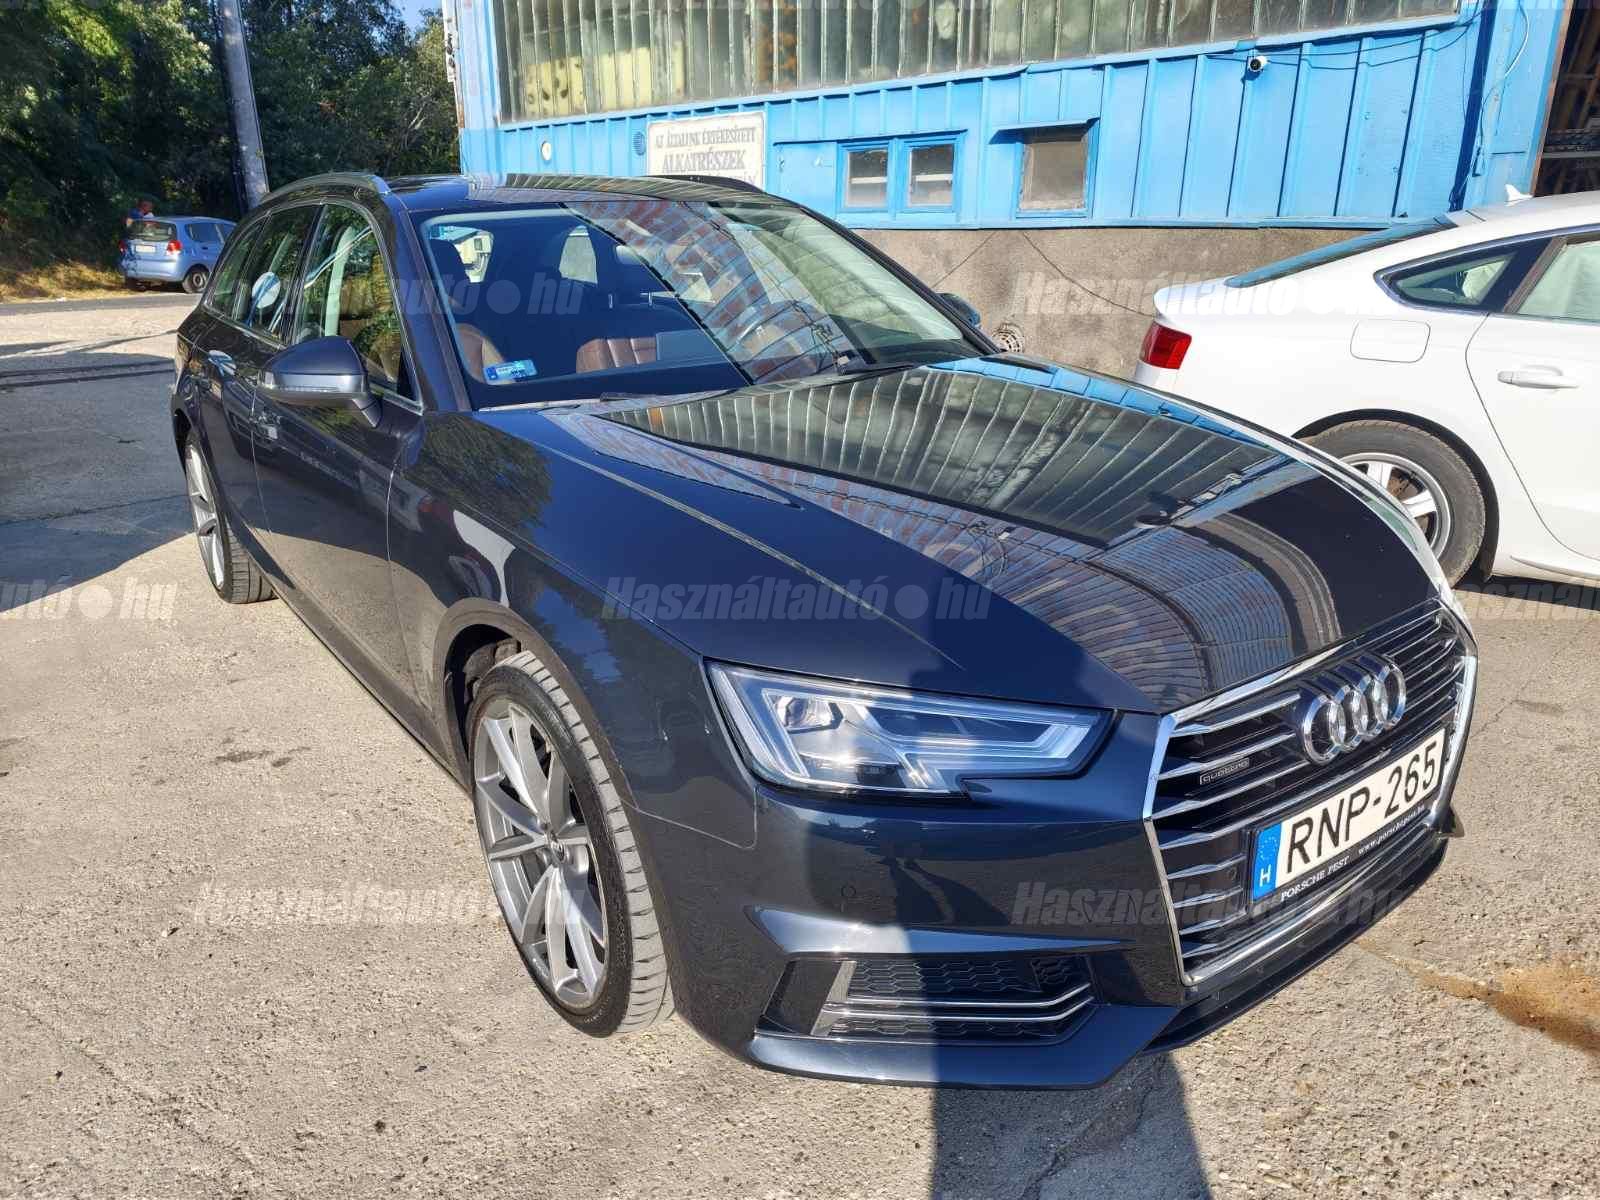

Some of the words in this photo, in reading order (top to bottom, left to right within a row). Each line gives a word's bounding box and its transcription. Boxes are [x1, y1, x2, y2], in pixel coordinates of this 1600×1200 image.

[1258, 864, 1272, 888] H
[1285, 740, 1438, 874] RNP-265
[1280, 870, 1326, 901] PORSCHE
